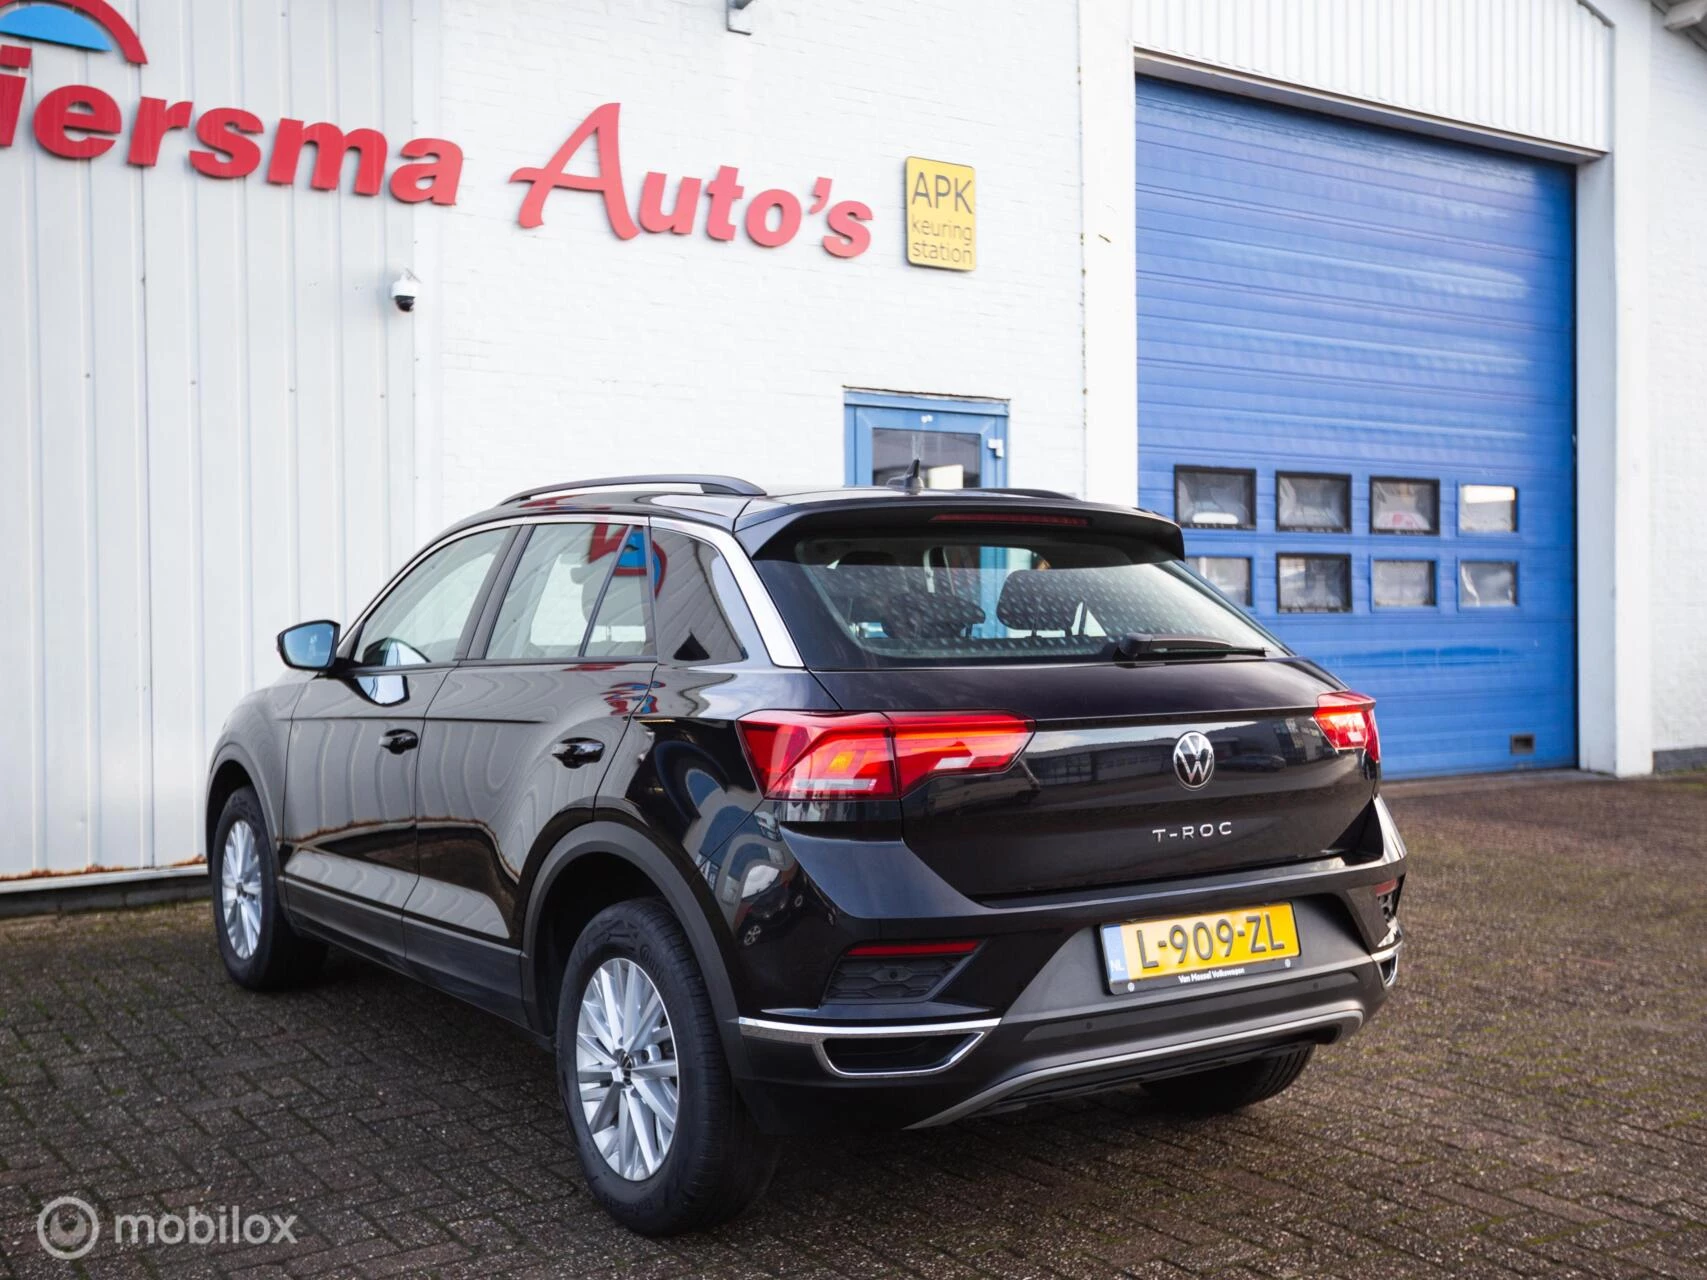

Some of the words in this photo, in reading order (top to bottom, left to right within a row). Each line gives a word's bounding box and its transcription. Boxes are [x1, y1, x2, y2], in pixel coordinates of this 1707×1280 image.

[508, 102, 874, 259] Auto's
[911, 171, 973, 215] APK
[911, 213, 973, 246] keuring
[911, 239, 973, 265] station
[1152, 821, 1232, 843] T-ROC
[1136, 913, 1285, 969] L-909-ZL
[1110, 959, 1125, 972] NL
[1178, 974, 1191, 984] Van
[1212, 967, 1245, 979] Volkswagen
